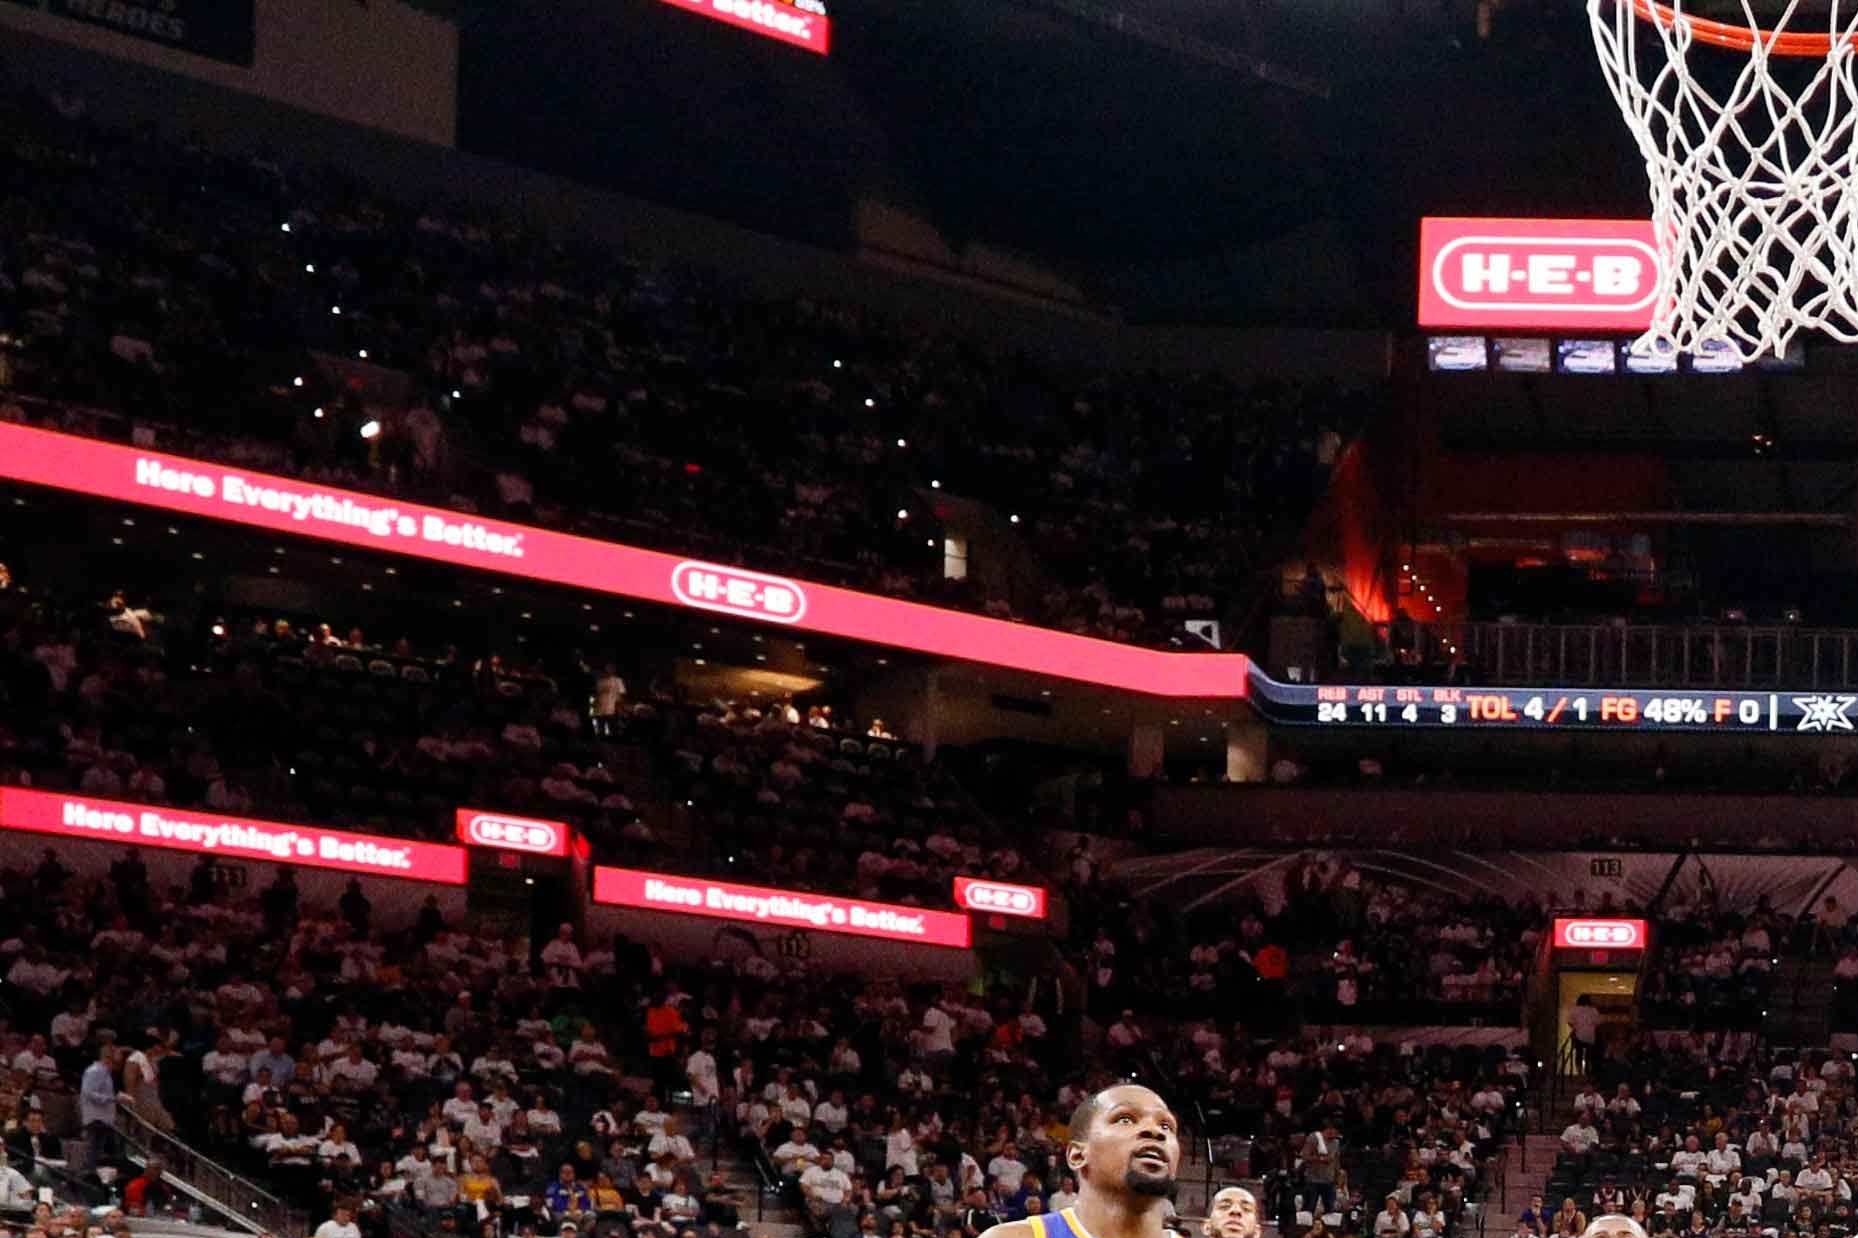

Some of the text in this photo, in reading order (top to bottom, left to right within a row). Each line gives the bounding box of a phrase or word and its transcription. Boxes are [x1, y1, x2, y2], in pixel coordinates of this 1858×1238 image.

[136, 459, 215, 497] Here
[222, 475, 417, 535] Everything's
[1317, 702, 1456, 723] 24 11 4 3
[1318, 687, 1461, 702] REB AST STL BLK
[1467, 695, 1519, 721] TOL
[1601, 697, 1638, 721] FG
[1713, 698, 1730, 723] F
[63, 803, 134, 834] Here
[141, 808, 313, 858] Everything's
[645, 879, 700, 906] Here
[706, 887, 844, 925] Everything's
